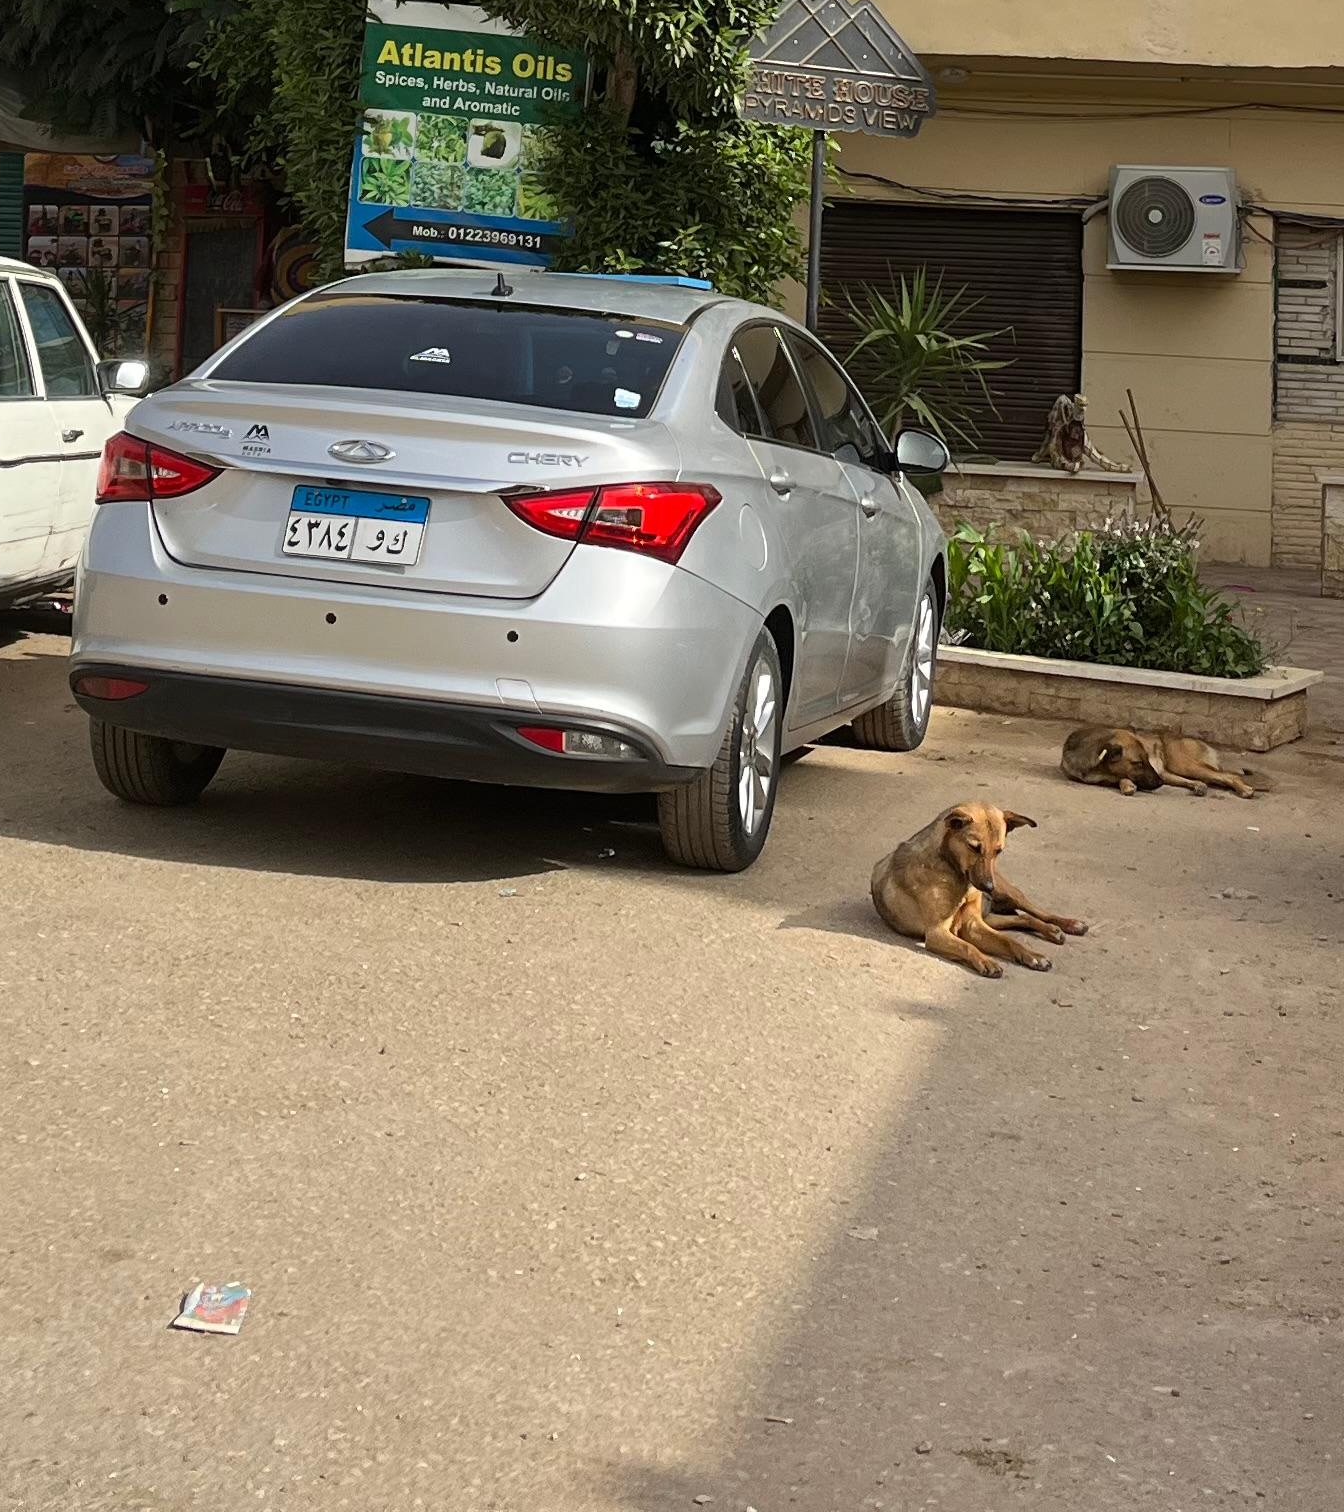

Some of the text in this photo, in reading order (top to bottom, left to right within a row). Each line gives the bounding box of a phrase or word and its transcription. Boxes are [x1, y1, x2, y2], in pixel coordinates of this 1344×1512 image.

[377, 40, 574, 82] Atlantis Oils
[375, 71, 571, 102] Spices, Herbs, Natural Oils
[752, 70, 929, 113] HITE HOUSE
[422, 95, 521, 116] and Aromatic
[743, 94, 919, 131] PYRAMIDS VIEW
[448, 227, 541, 248] 01223969131
[507, 452, 590, 468] CHERY
[304, 492, 351, 509] EGYPT
[374, 499, 416, 513] مصر
[287, 518, 350, 552] ٤٣٨٤
